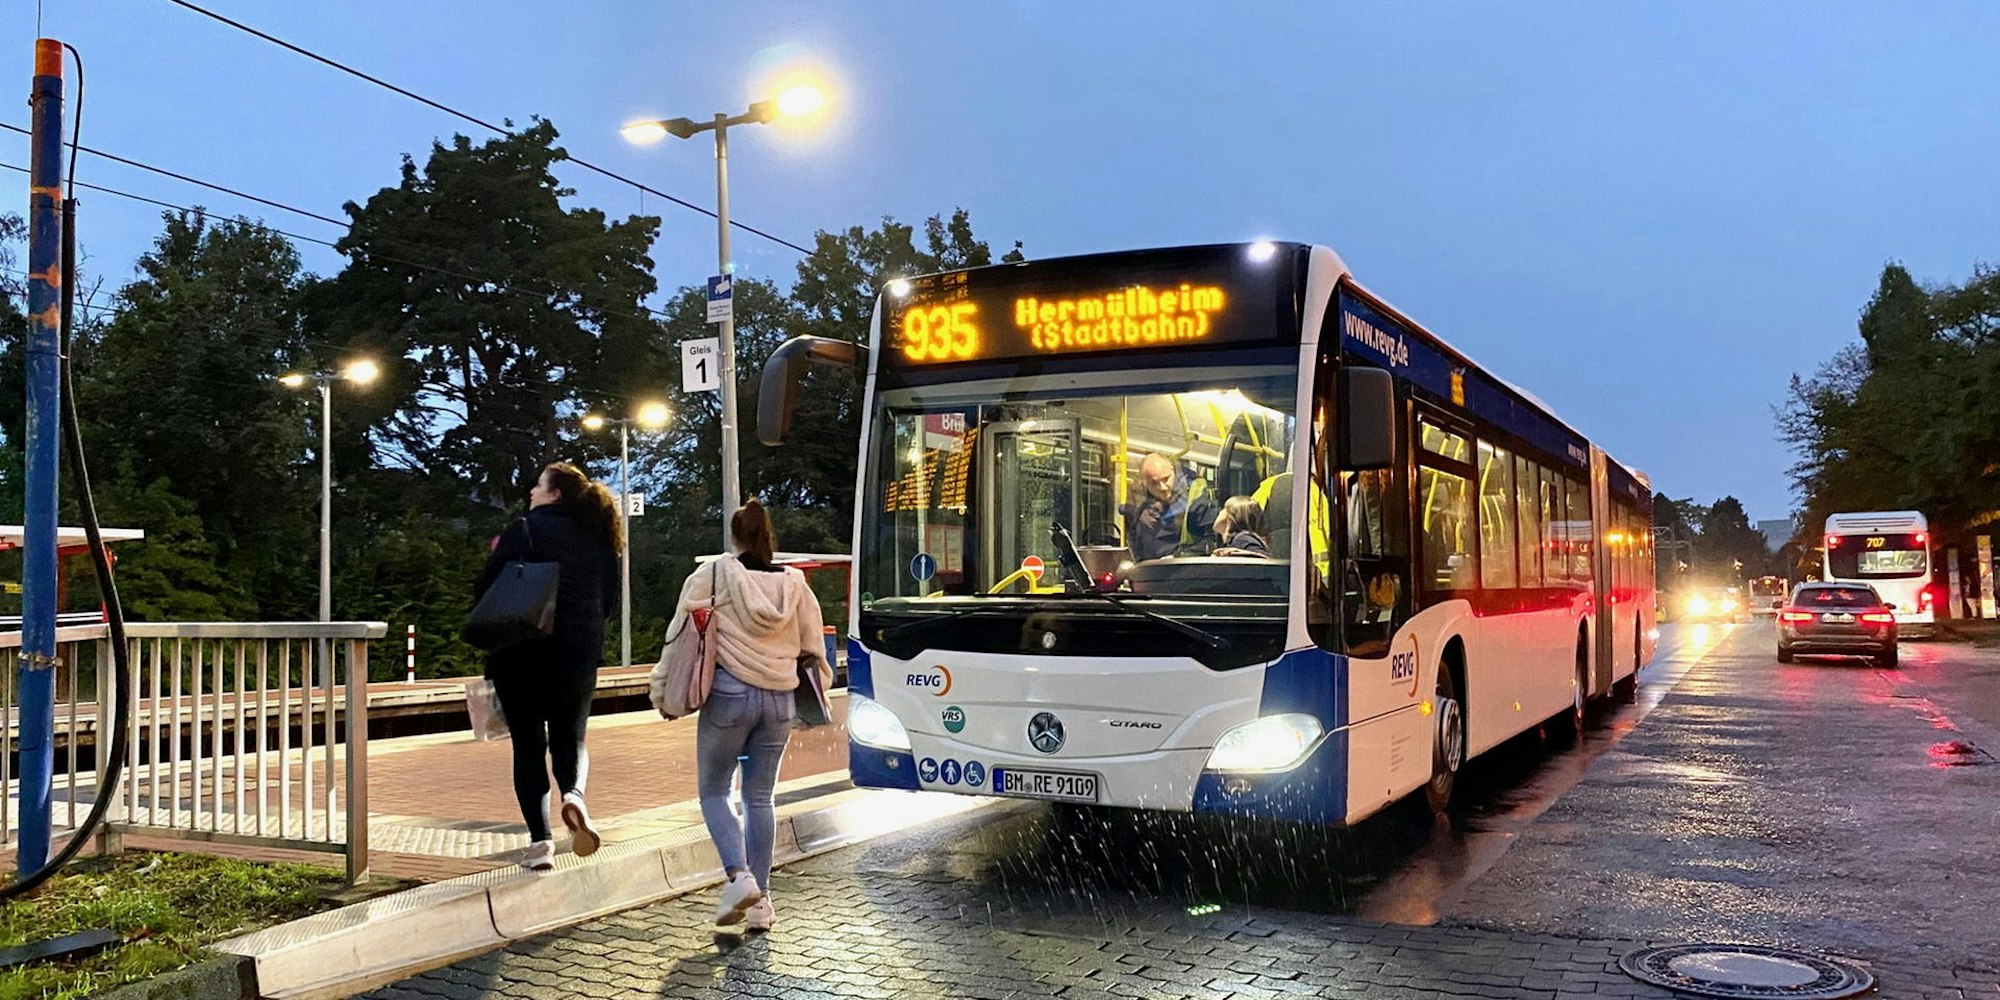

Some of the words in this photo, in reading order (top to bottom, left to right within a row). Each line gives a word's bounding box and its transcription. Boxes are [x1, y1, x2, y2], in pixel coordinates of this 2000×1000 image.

[1016, 284, 1225, 328] Hermülheim
[902, 302, 978, 361] 935
[1031, 311, 1208, 350] (Stadtbahn)
[1344, 310, 1409, 368] www.revg.de
[689, 345, 712, 355] Gleis
[695, 357, 707, 384] 1
[633, 501, 640, 513] 2
[1866, 537, 1886, 548] 707
[1391, 651, 1414, 679] REVG
[906, 674, 941, 687] REVG
[941, 711, 960, 721] VRS
[1110, 720, 1162, 730] CITARO
[1004, 772, 1024, 792] BM
[1033, 774, 1053, 794] RE
[1056, 776, 1094, 797] 9109
